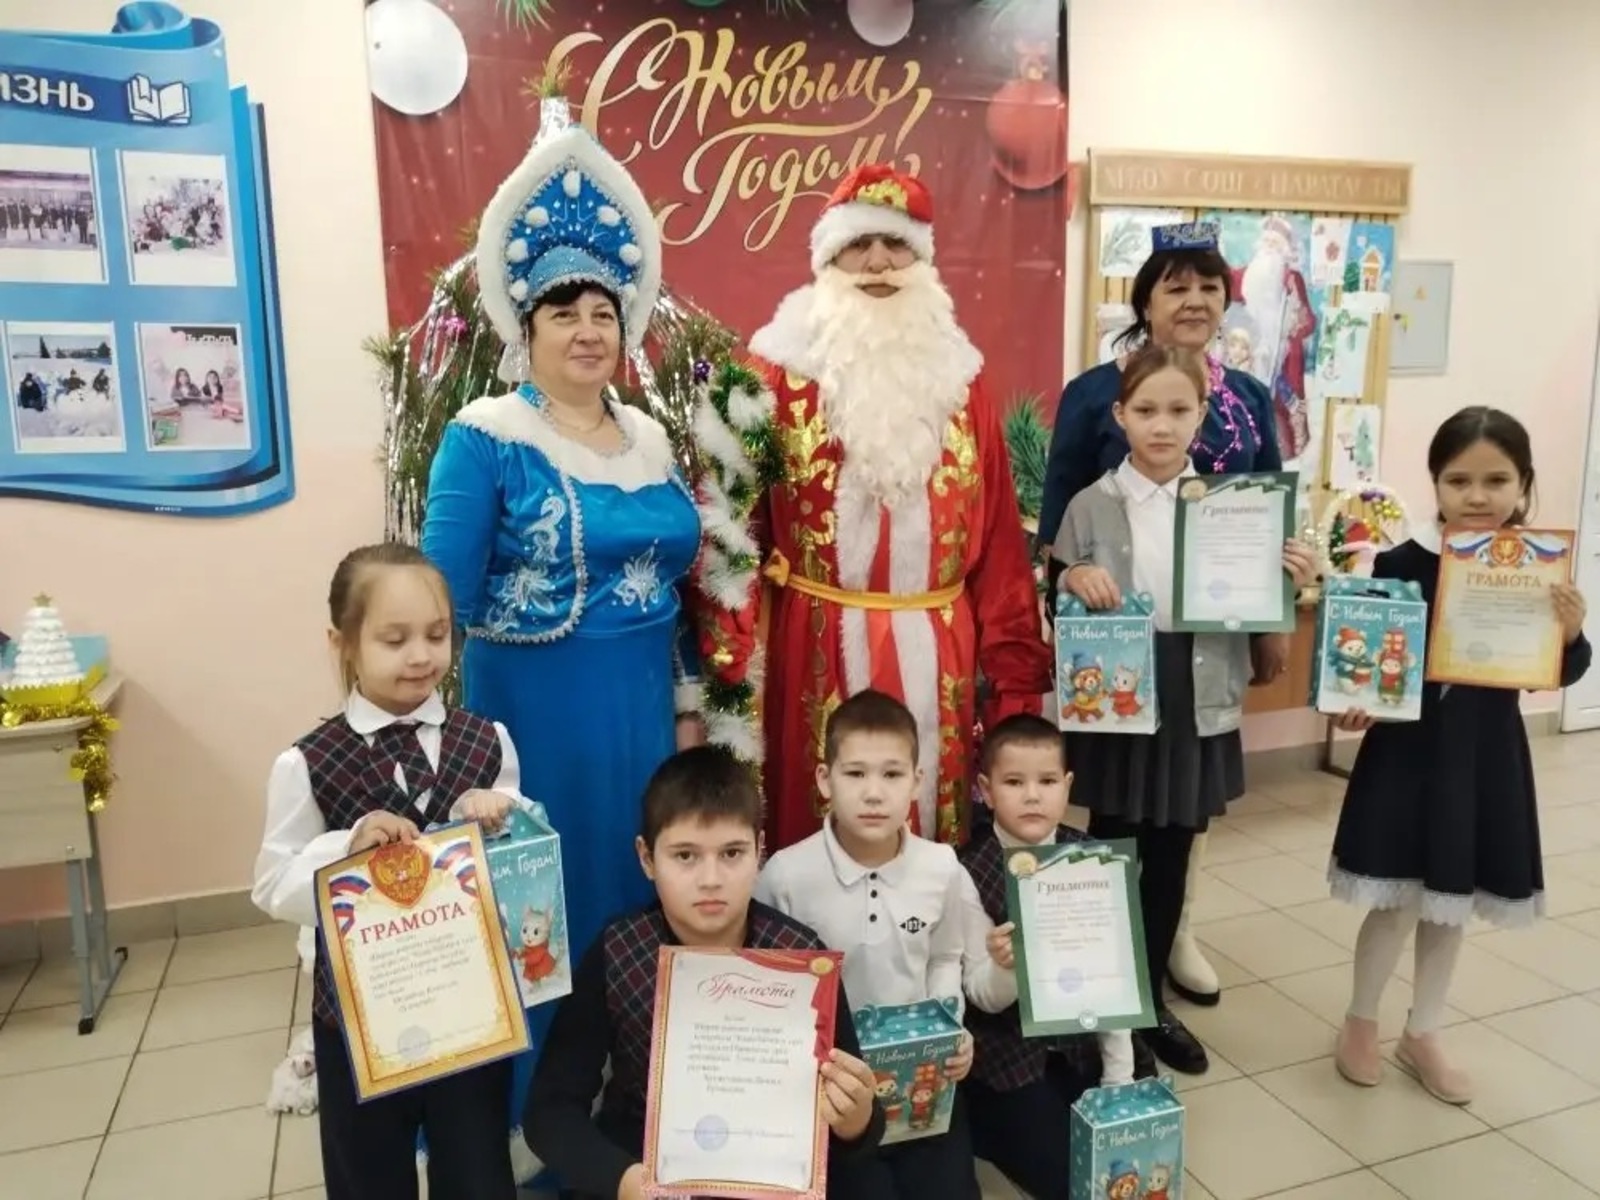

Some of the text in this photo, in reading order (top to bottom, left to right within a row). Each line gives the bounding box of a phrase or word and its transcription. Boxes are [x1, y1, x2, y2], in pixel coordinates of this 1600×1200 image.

[637, 28, 922, 151] Новым
[1466, 571, 1541, 587] ГРАМОТА
[1037, 880, 1110, 896] Грамота
[359, 902, 467, 945] ГРАМОТА
[698, 972, 796, 1006] Грамота
